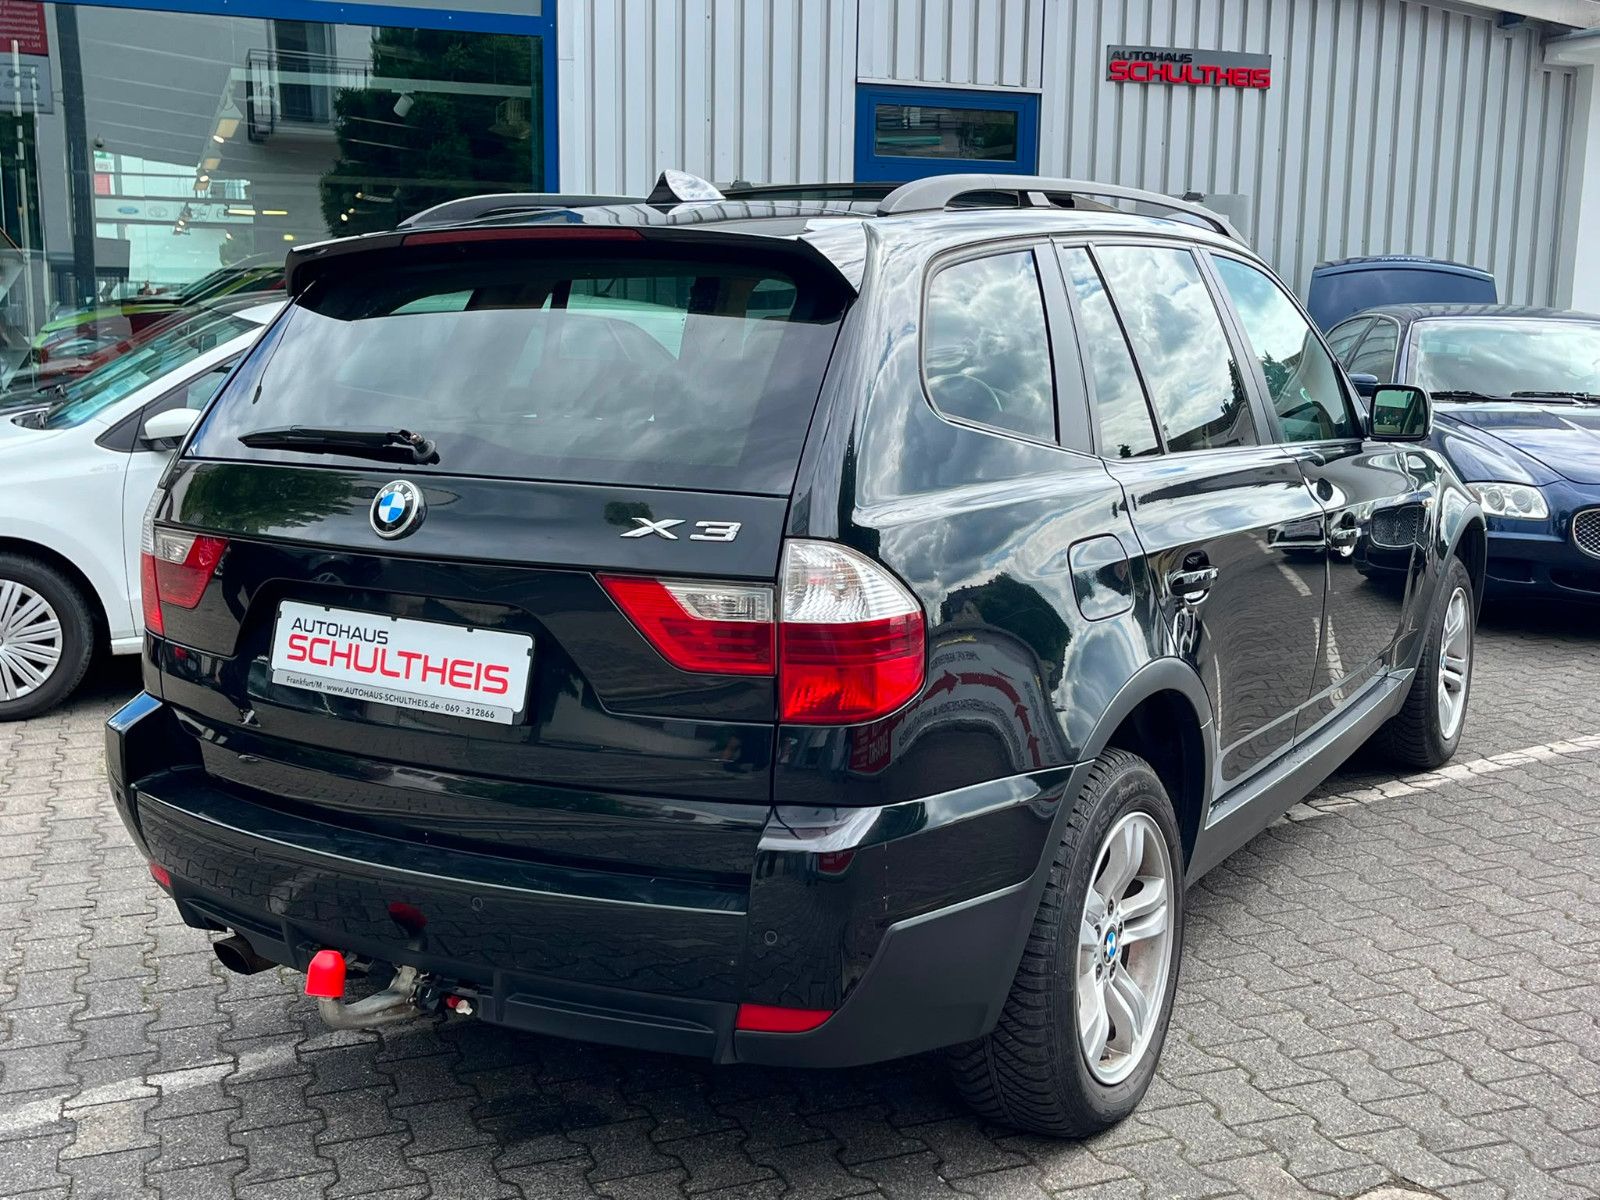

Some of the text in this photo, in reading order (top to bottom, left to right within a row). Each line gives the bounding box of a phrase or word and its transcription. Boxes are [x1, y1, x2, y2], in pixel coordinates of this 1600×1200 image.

[1110, 50, 1193, 63] AUTOHAUS
[1109, 61, 1271, 88] SCHULTHEIS
[291, 617, 389, 645] AUTOHAUS
[287, 633, 509, 695] SCHULTHEIS
[286, 675, 322, 689] Frankfurt/M
[444, 703, 460, 713] 069
[465, 706, 496, 719] 312866
